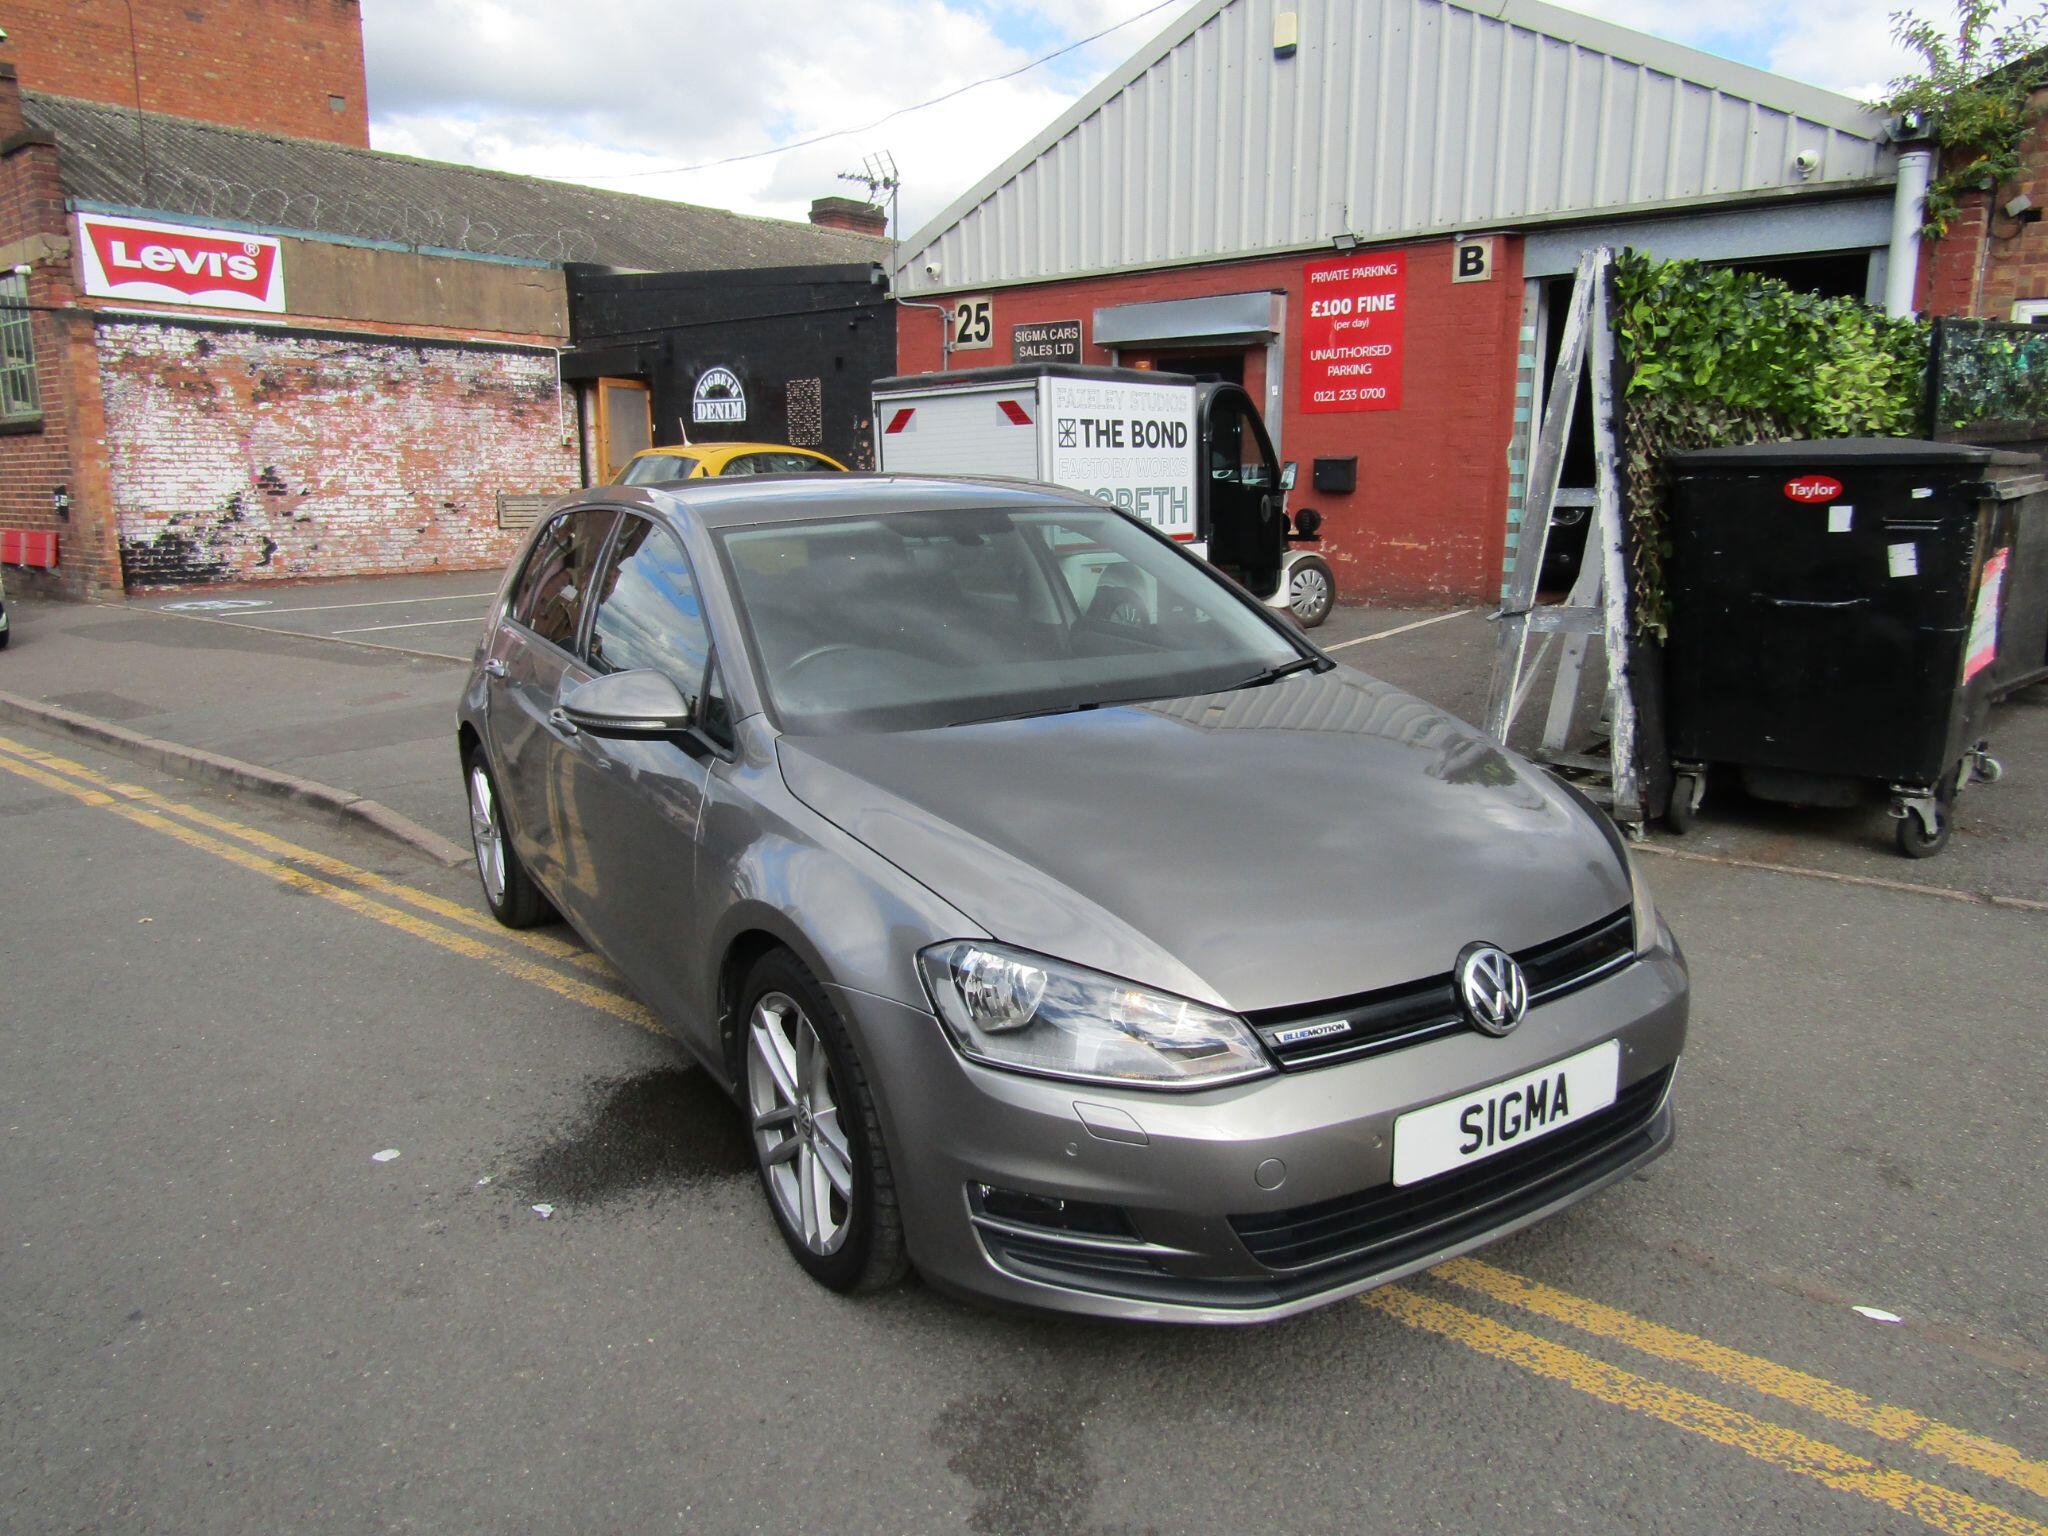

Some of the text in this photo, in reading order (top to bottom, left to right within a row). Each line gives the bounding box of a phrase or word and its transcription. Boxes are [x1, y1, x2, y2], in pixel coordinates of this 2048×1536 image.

[1459, 245, 1485, 277] B
[1311, 264, 1397, 284] PRIVATE PARKING
[1310, 294, 1396, 318] £100 FINE
[957, 302, 991, 344] 25
[1334, 317, 1370, 332] (per day)
[1015, 327, 1079, 343] SIGMA CARS
[1019, 343, 1074, 358] SALES LTD
[1310, 344, 1392, 361] UNAUTHORISED
[1327, 363, 1373, 377] PARKING
[699, 373, 740, 398] DIGBETH
[1313, 387, 1386, 402] 0121 233 0700
[697, 402, 742, 420] DENIM
[1080, 419, 1188, 448] THE BOND
[1058, 456, 1189, 480] FACTORY WORKS
[1789, 482, 1836, 499] Taylor
[1283, 1023, 1345, 1041] BLUEMOTION
[1459, 1072, 1568, 1155] SIGMA
